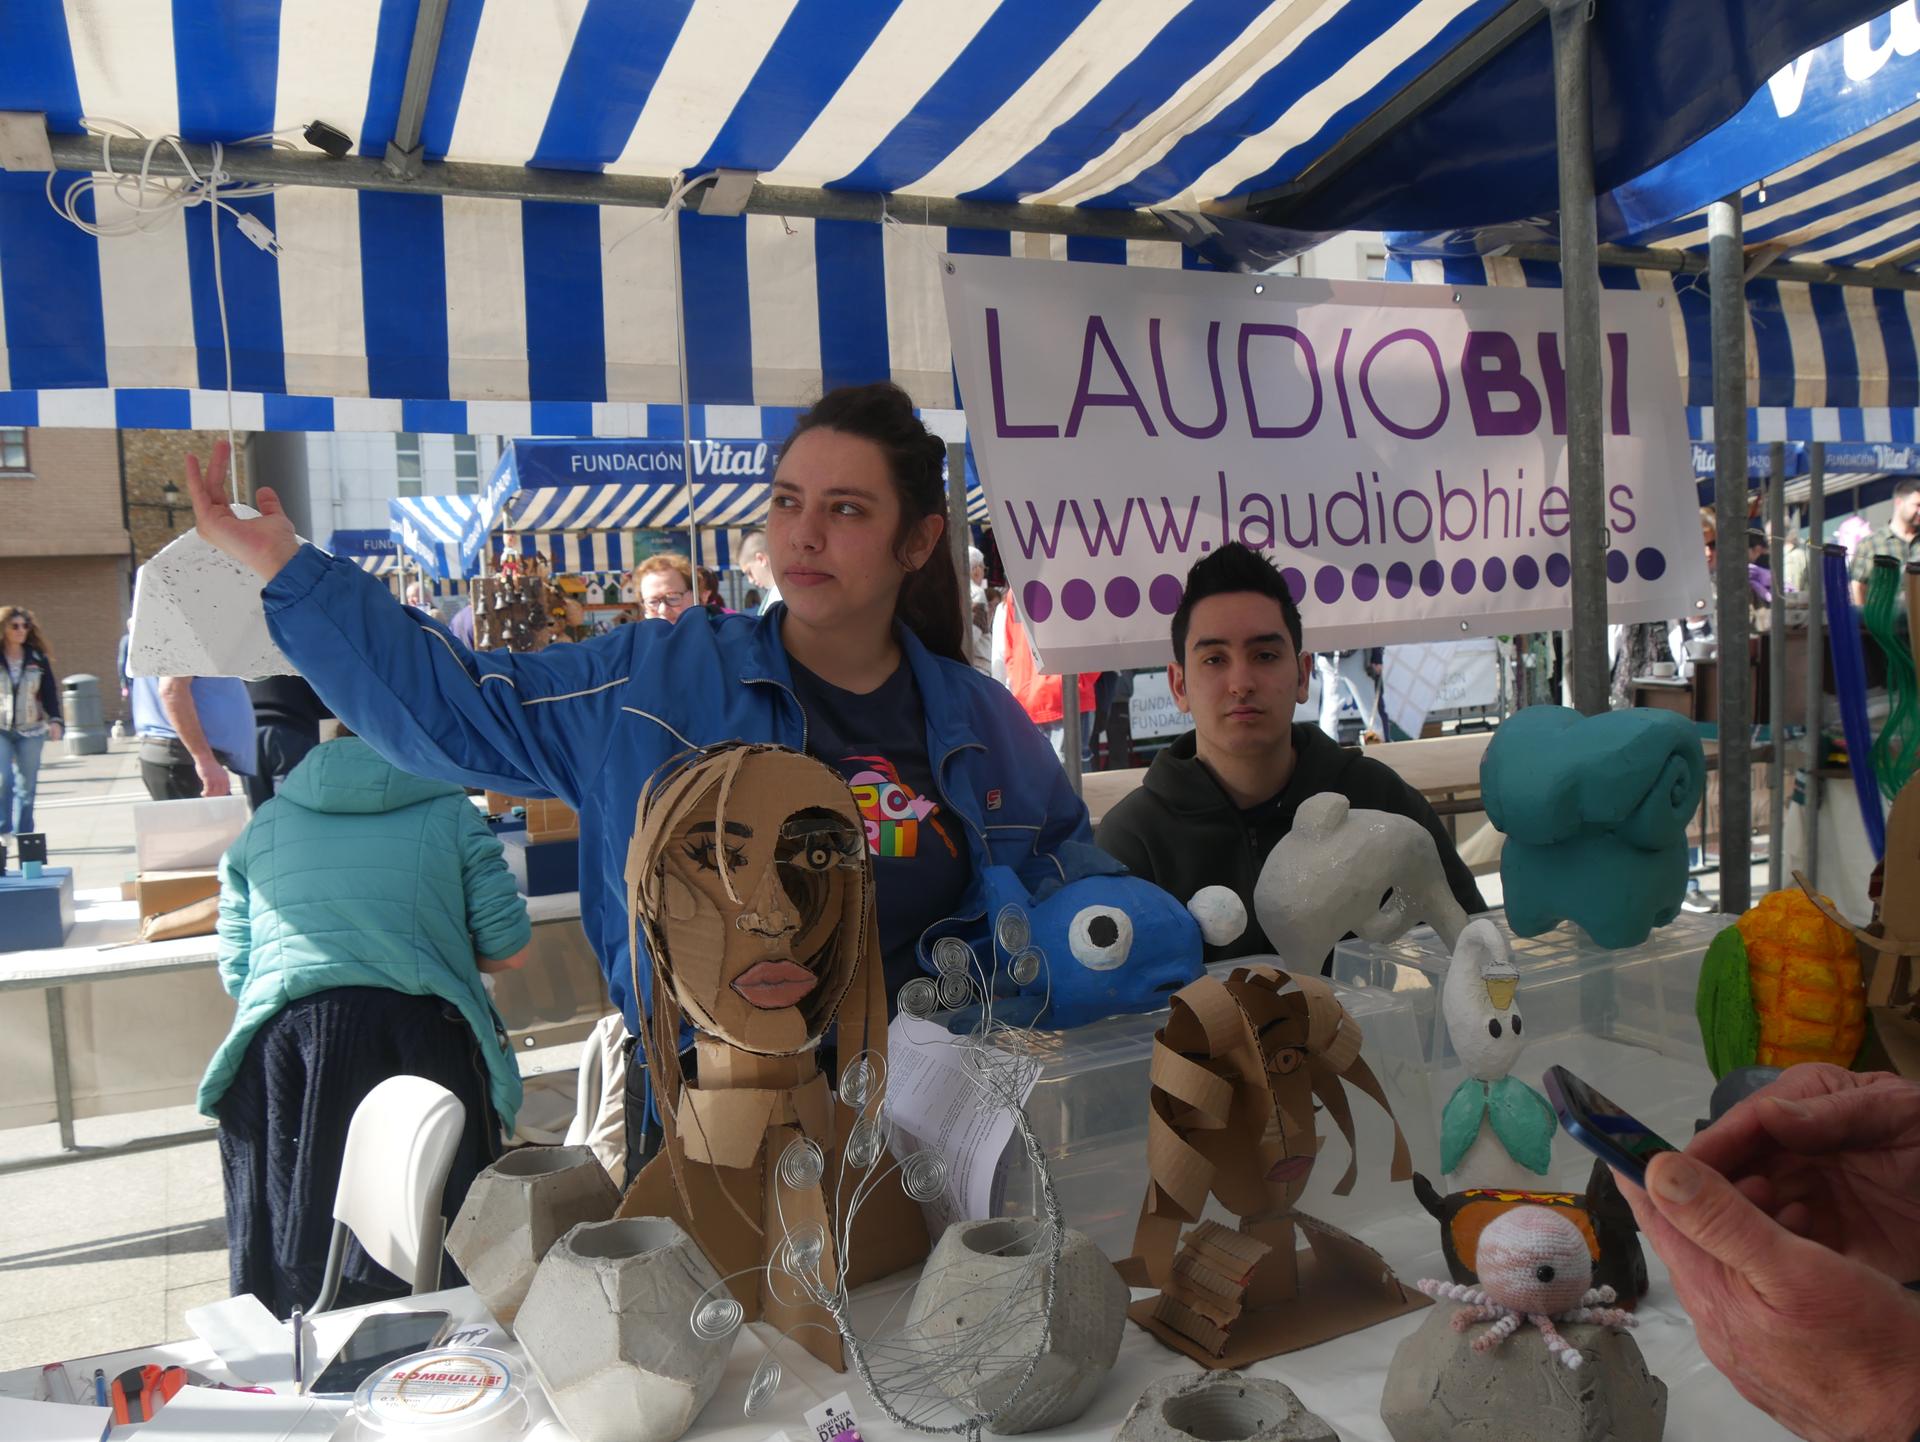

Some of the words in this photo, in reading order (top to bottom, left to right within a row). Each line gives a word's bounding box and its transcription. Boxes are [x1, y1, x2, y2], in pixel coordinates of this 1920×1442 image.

[571, 452, 682, 473] FUNDACIÓN
[689, 440, 768, 476] Vital
[1005, 468, 1636, 560] www.laudiobhi.es
[363, 538, 395, 551] FUND
[1132, 696, 1174, 712] FUNDA
[818, 1417, 856, 1442] DENA
